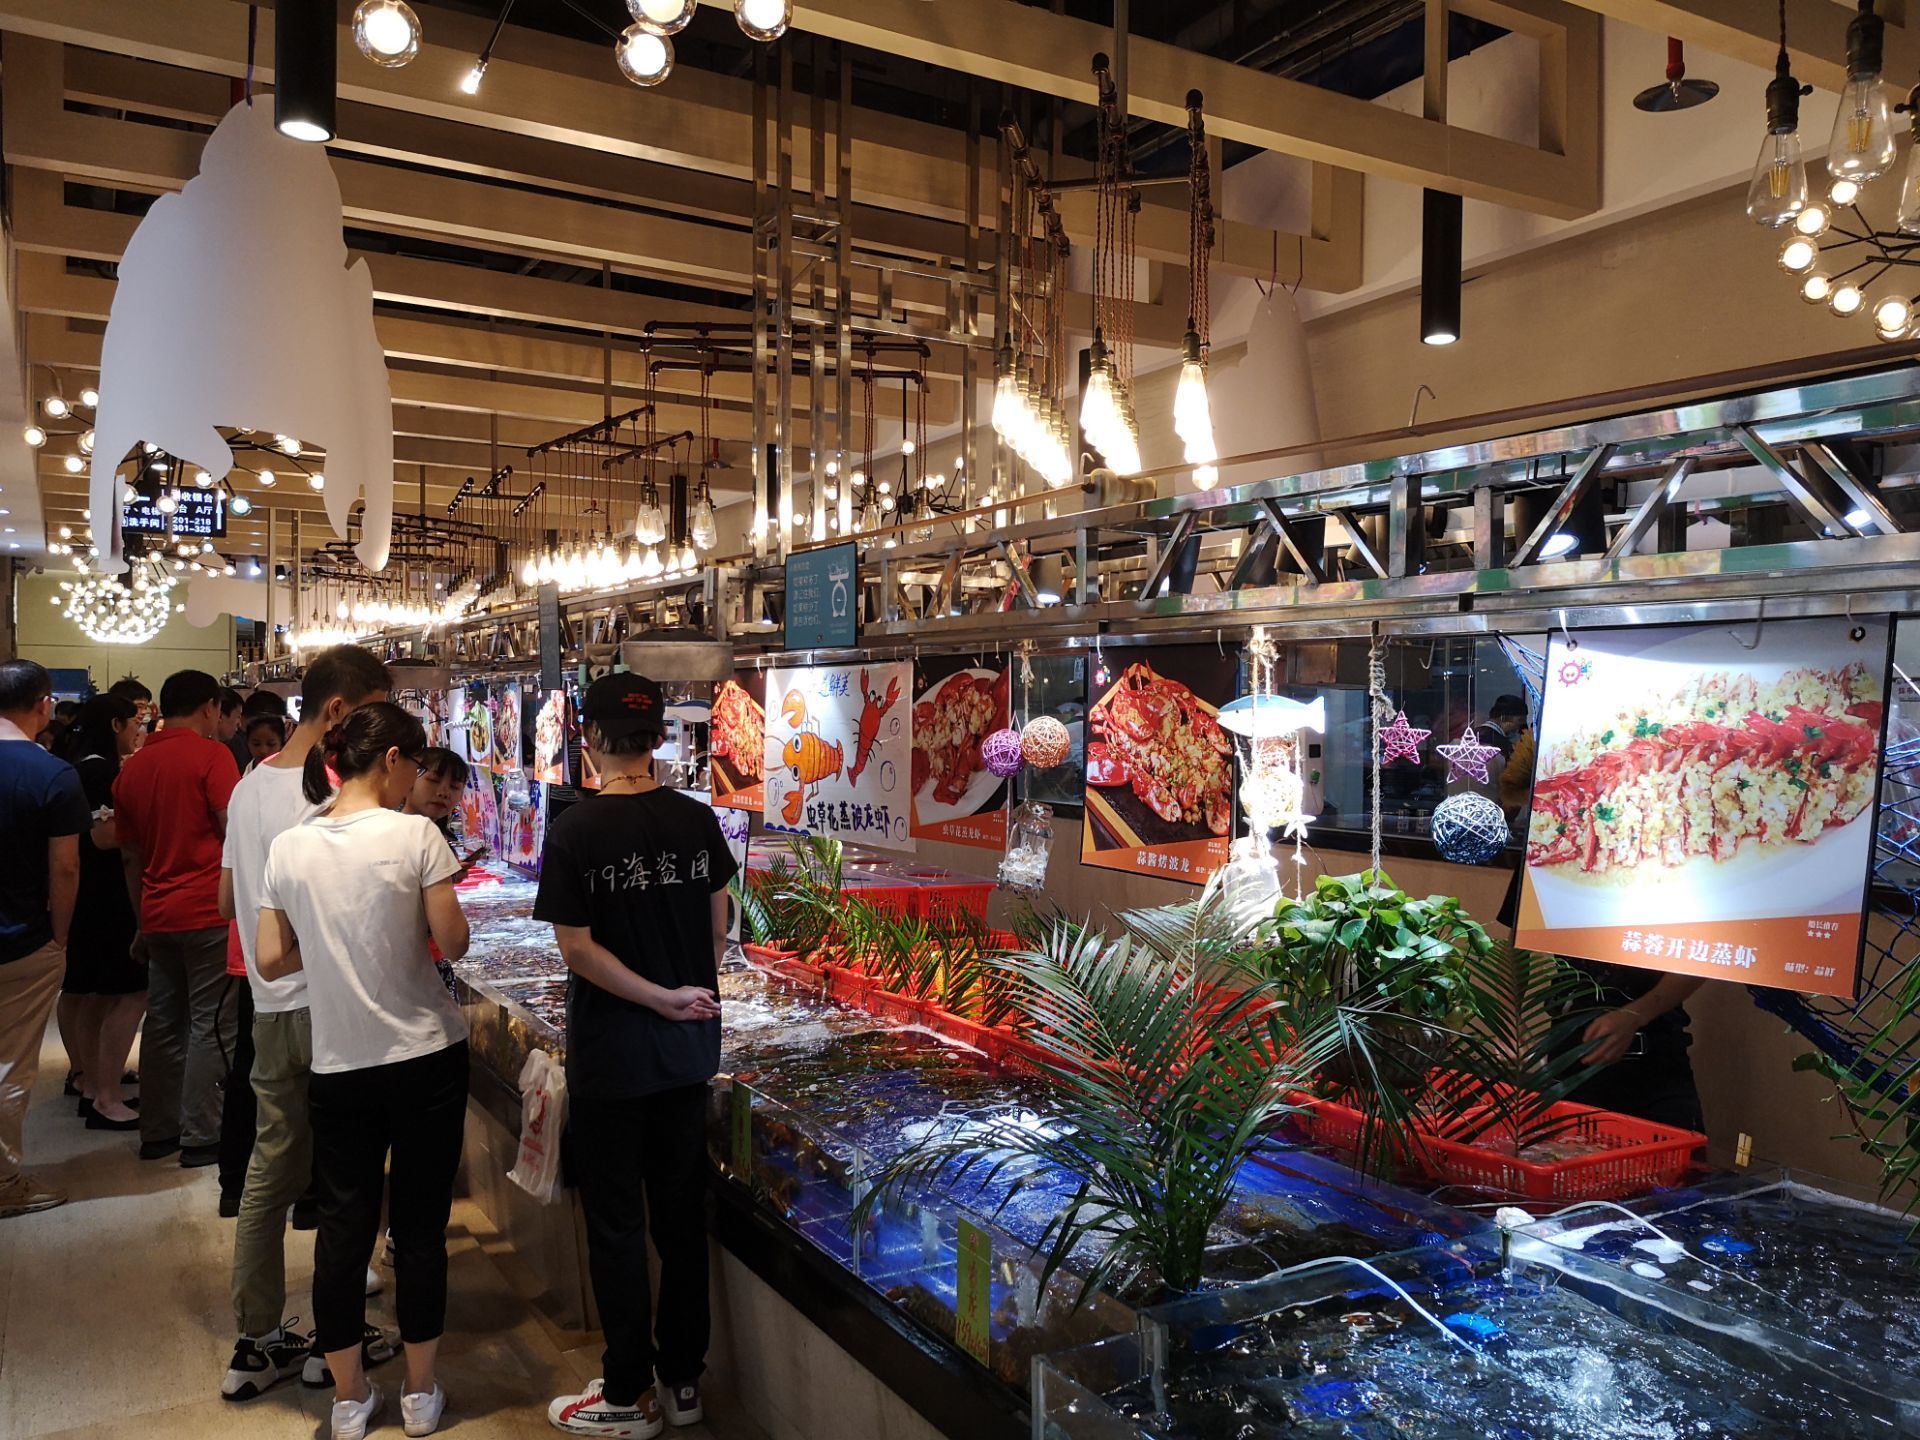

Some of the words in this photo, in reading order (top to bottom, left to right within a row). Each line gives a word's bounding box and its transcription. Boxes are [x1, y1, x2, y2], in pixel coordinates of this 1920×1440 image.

[1622, 931, 1758, 968] 蒜蓉开边蒸虾
